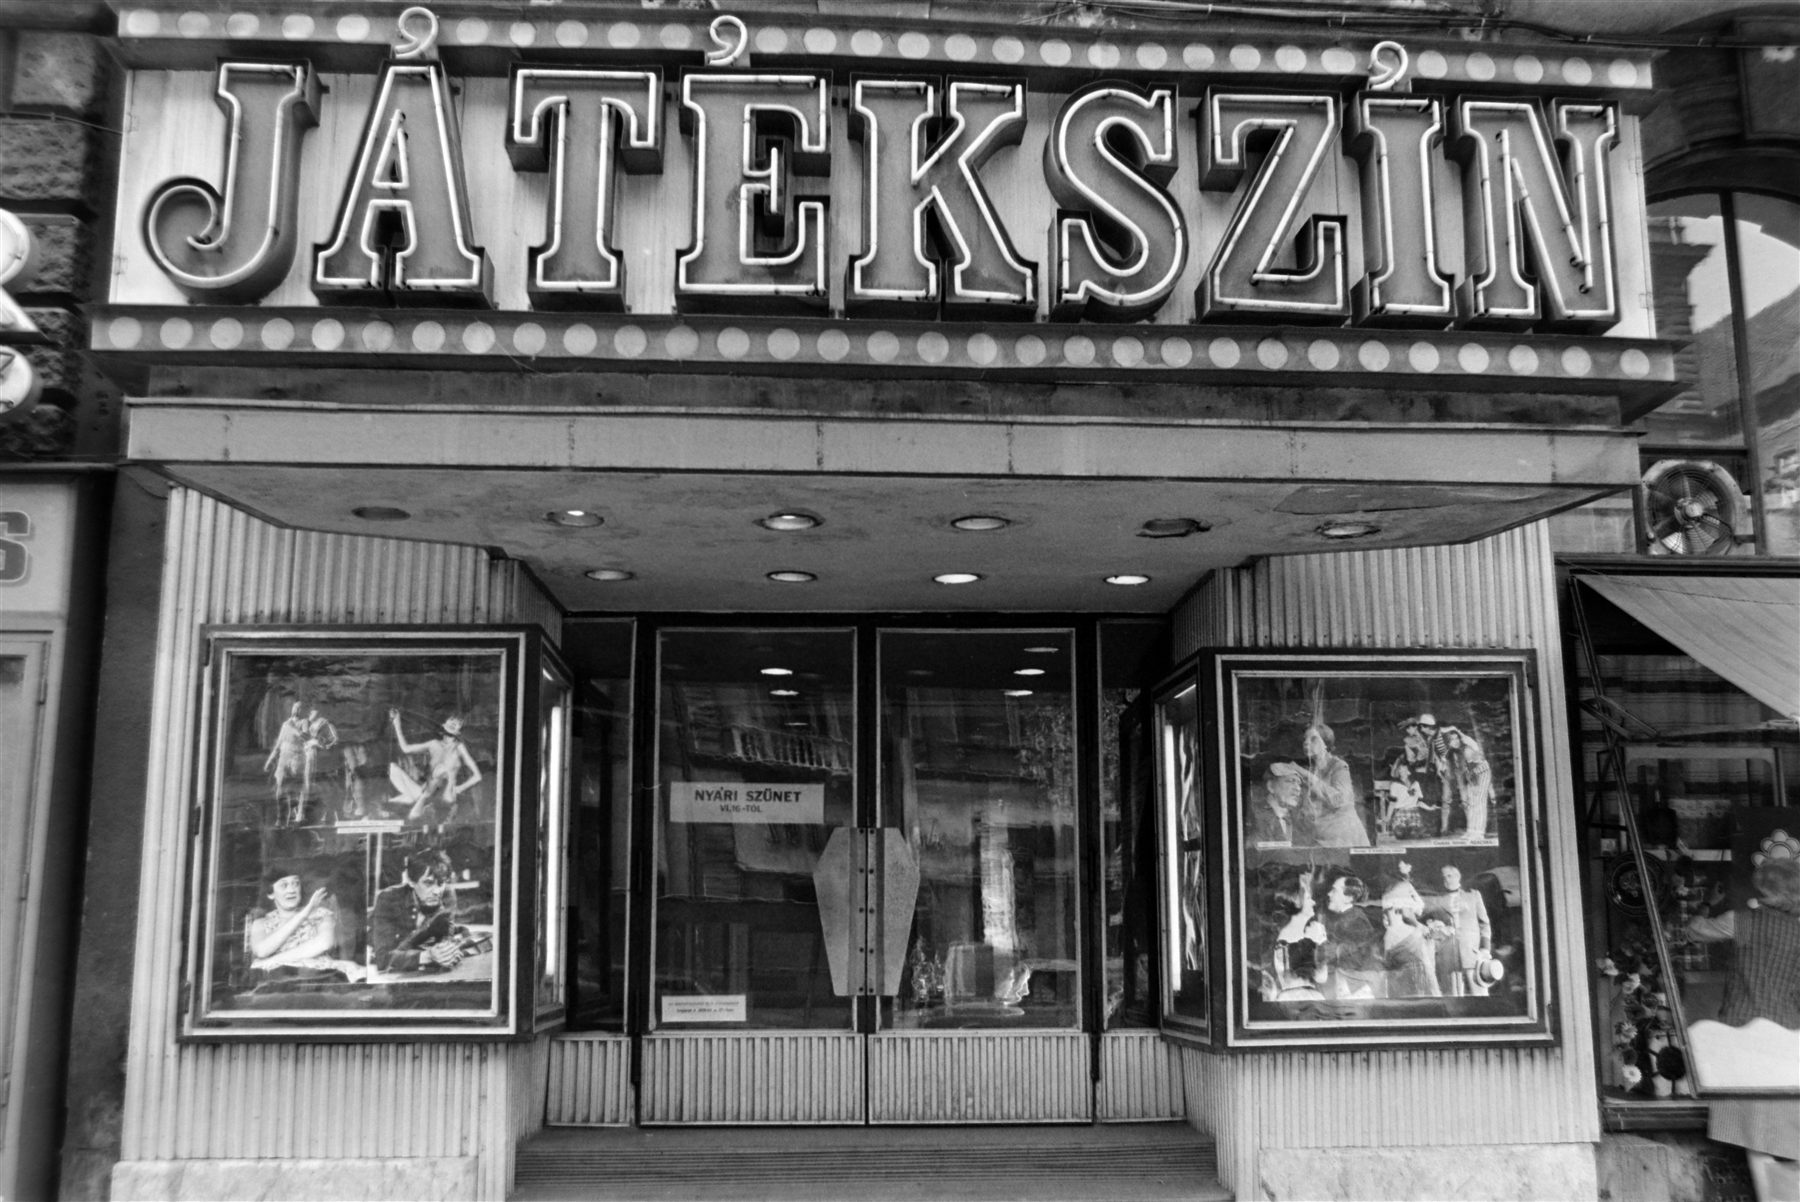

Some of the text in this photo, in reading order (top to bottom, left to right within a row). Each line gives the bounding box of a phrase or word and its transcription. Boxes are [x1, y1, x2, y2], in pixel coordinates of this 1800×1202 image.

[142, 6, 1622, 325] JÁTÉKSZÍN
[694, 786, 802, 803] NYÁRI SZÜNET
